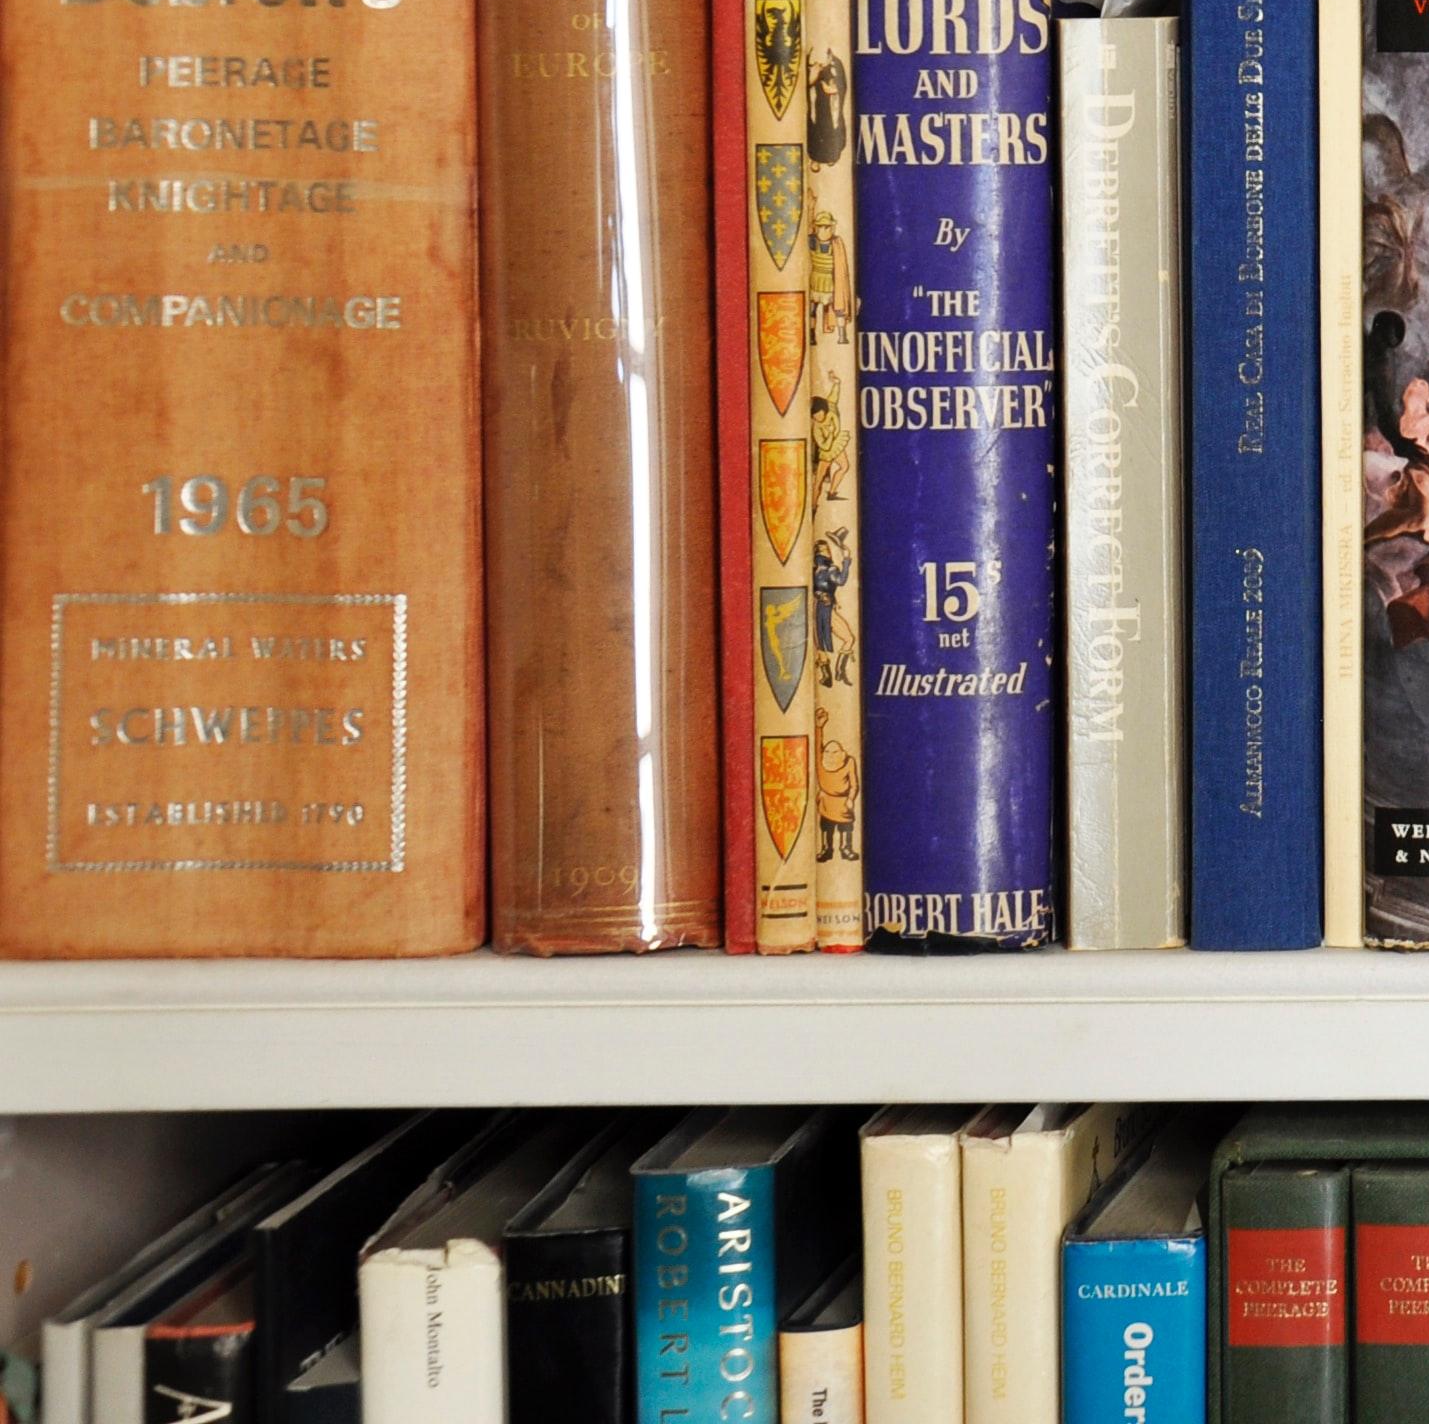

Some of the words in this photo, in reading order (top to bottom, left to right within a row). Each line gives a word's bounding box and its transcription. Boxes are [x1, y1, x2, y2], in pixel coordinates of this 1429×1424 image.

[138, 55, 332, 89] PEERAGE
[913, 68, 979, 101] AND
[88, 118, 380, 154] BARONETAGE
[856, 110, 1049, 168] MASTERS
[106, 180, 357, 214] KNIGHTAGE
[933, 217, 972, 251] By
[59, 292, 402, 331] COMPANIONAGE
[857, 330, 1052, 374] UNOFFICIAL
[140, 475, 329, 539] 1965
[938, 629, 971, 650] net
[875, 663, 1028, 698] Illustrated
[88, 707, 366, 747] SCHWEPPES
[885, 1188, 904, 1255] BRUNO
[425, 1264, 441, 1305] John
[655, 1192, 690, 1386] ROBERT
[886, 1261, 904, 1348] BERNARD
[1077, 1279, 1190, 1300] CARDINALE
[425, 1311, 441, 1390] Montalto
[886, 1354, 904, 1401] HEIM
